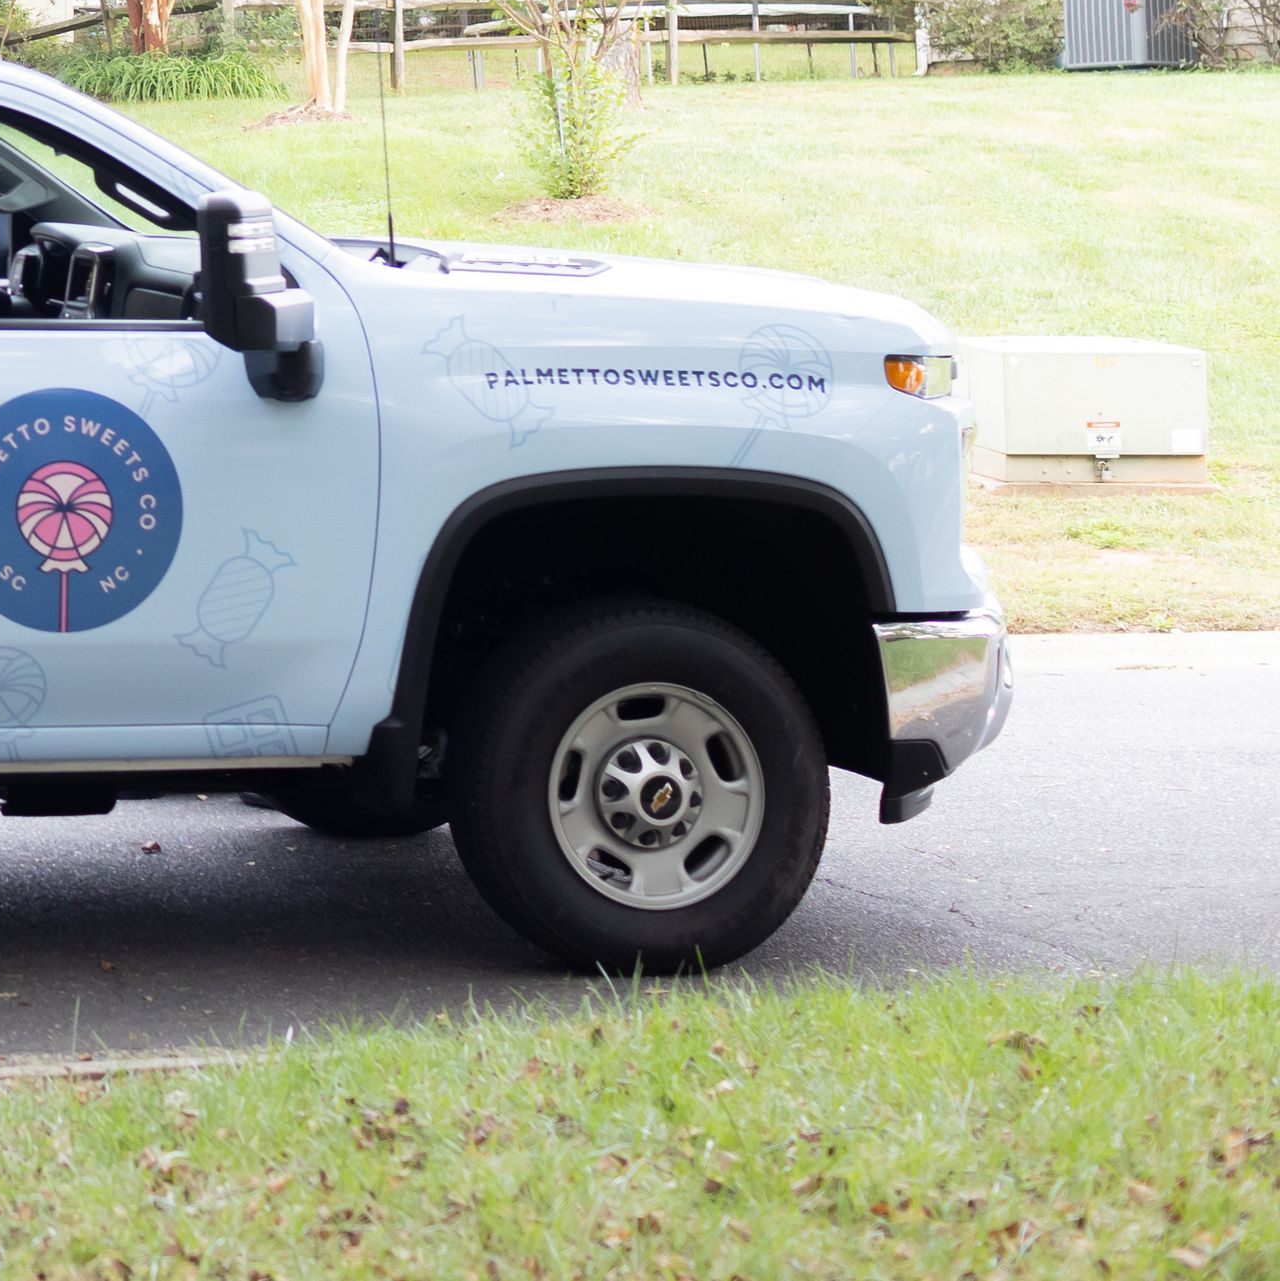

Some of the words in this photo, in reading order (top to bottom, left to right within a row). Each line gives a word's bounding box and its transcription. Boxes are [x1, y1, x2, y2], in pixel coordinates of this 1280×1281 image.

[485, 368, 826, 393] PALMETTOSWEETSCO.COM
[63, 415, 150, 483] SWEETS
[140, 494, 157, 531] CO
[99, 565, 130, 593] NC
